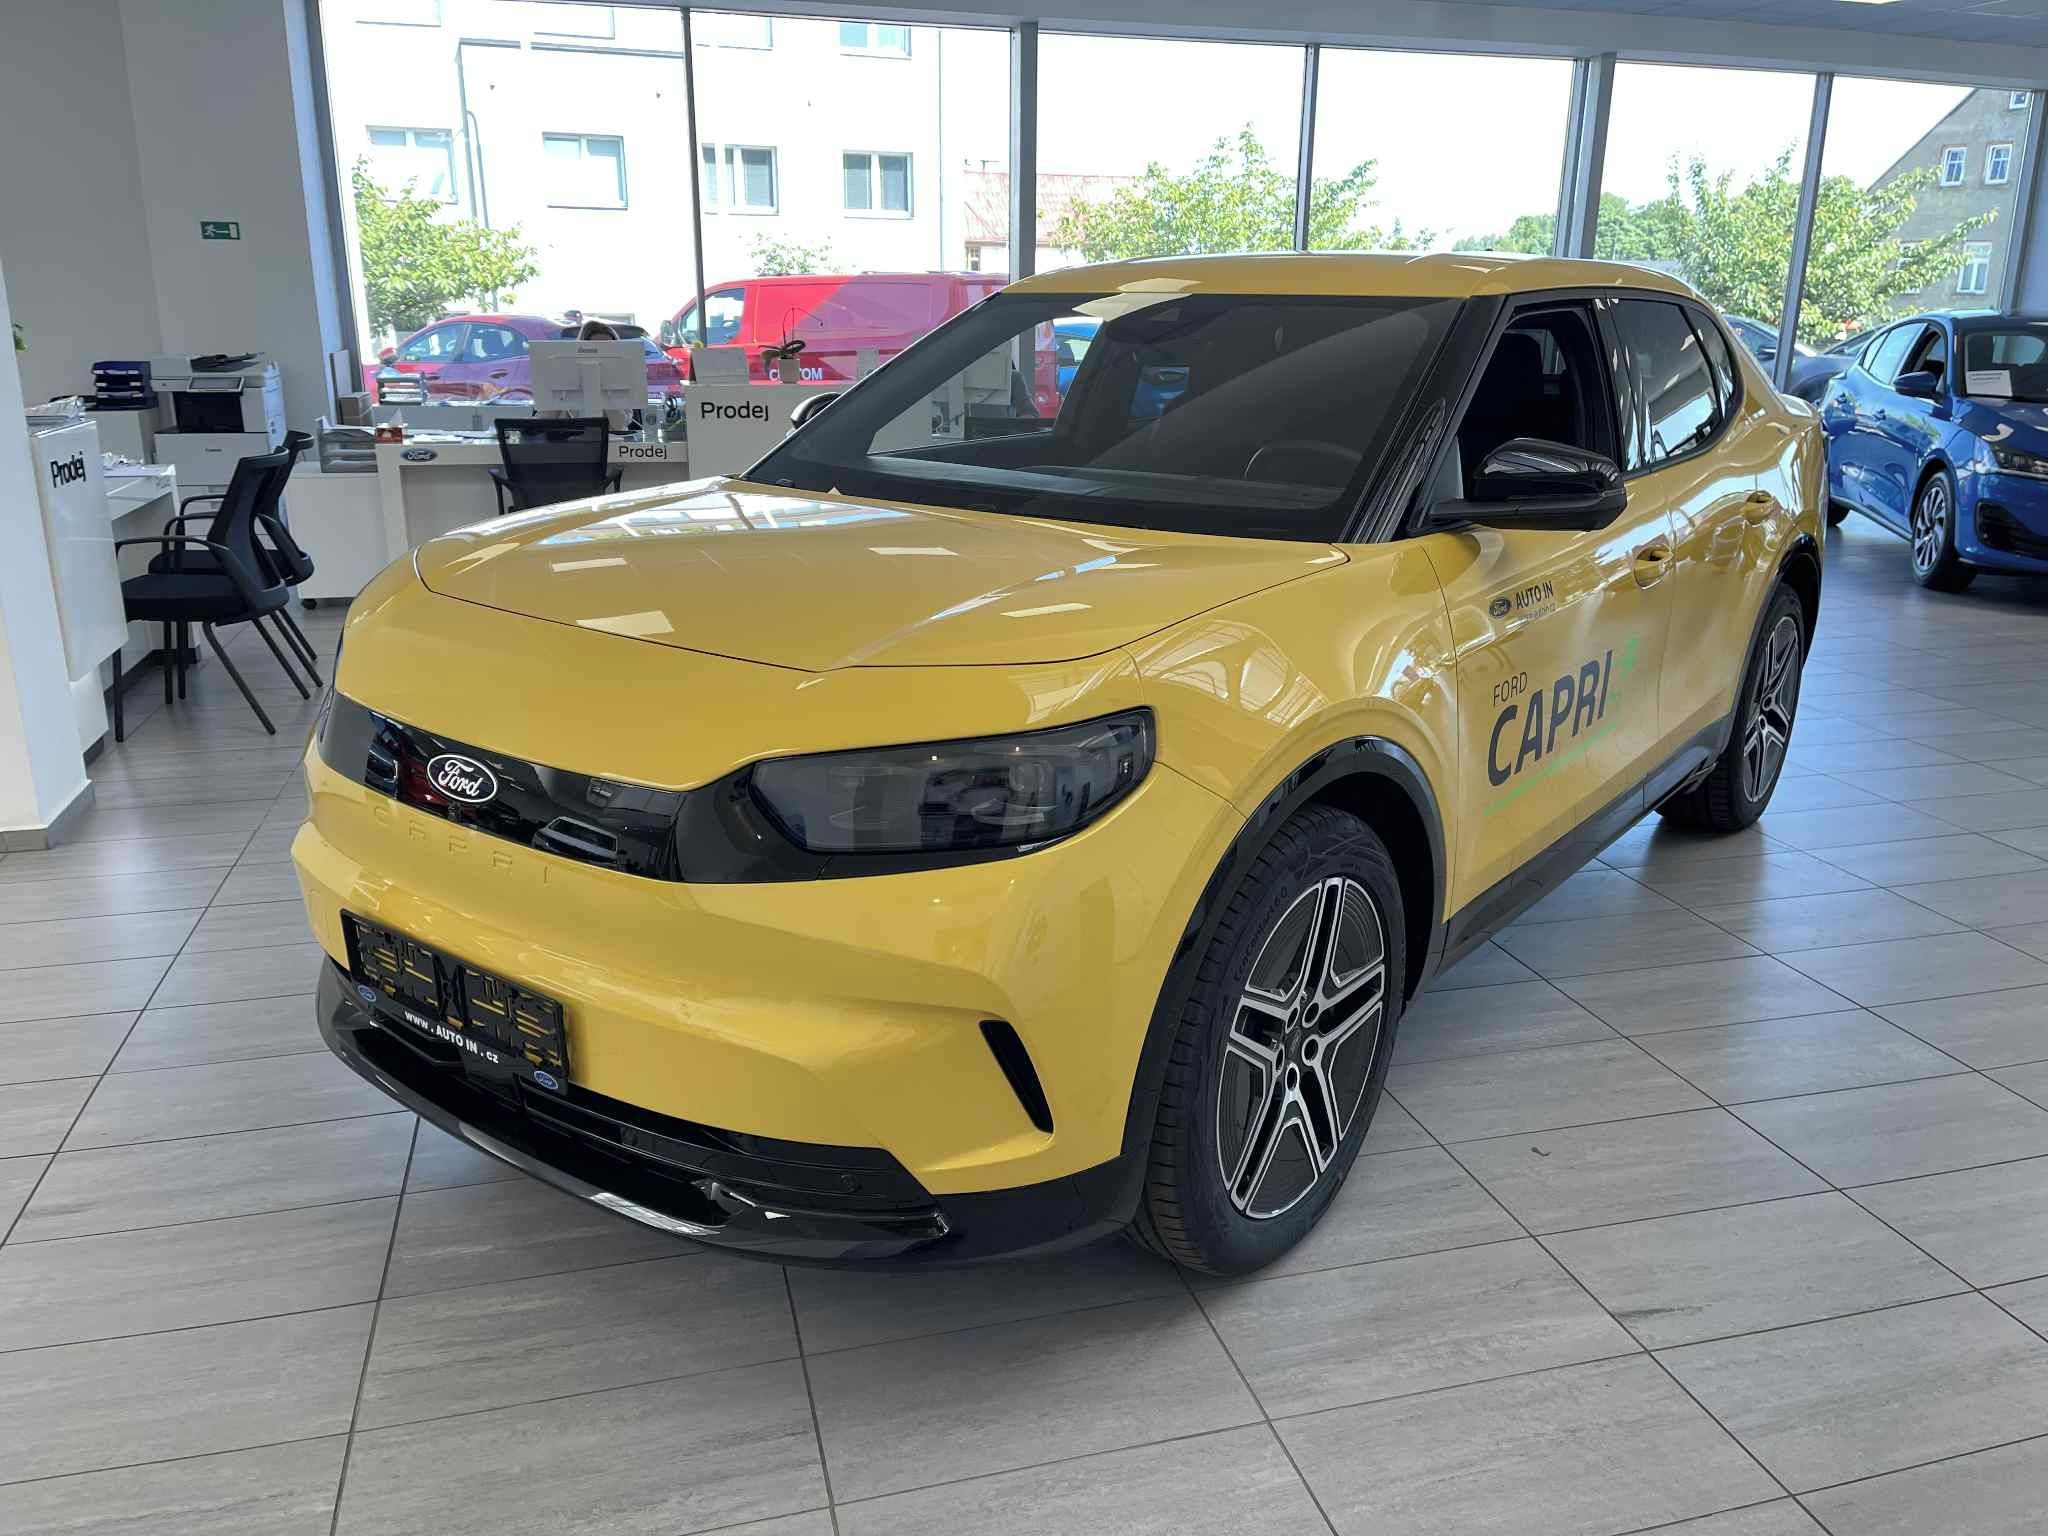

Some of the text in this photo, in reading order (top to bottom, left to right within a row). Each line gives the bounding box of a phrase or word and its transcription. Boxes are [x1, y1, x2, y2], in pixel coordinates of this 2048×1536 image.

[701, 401, 769, 421] Prodej
[619, 445, 667, 460] Prodej
[50, 451, 86, 488] Prodej
[1515, 580, 1554, 610] AUTO IN
[1493, 671, 1528, 707] FORD
[1488, 650, 1613, 786] CAPRI
[437, 759, 484, 797] Ford
[436, 1025, 464, 1047] AUTO
[465, 1039, 478, 1054] IN
